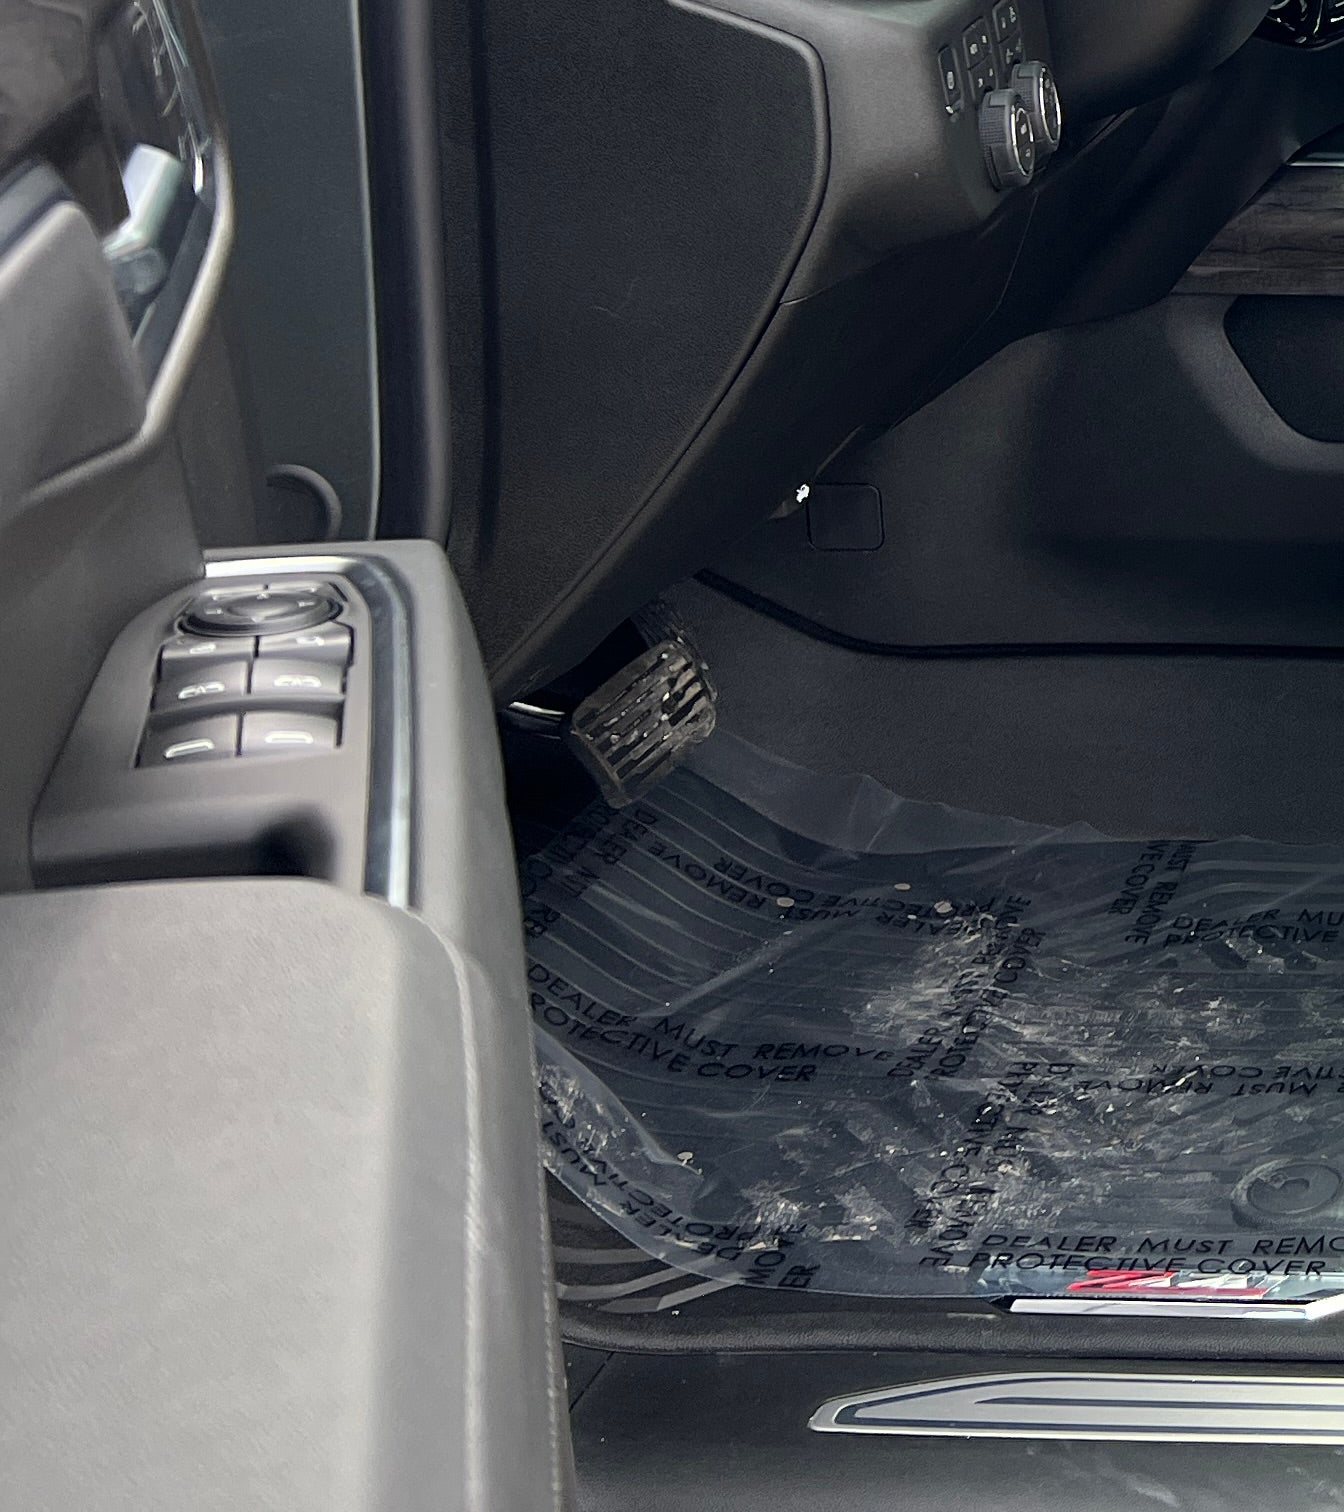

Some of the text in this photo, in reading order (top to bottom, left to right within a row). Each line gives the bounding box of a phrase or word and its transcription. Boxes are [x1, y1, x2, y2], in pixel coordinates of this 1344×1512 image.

[1172, 909, 1281, 930] DEALER
[526, 963, 895, 1063] DEALER MUST REMOVE
[697, 1062, 817, 1082] COVER
[982, 1234, 1117, 1254] DEALER
[1137, 1238, 1232, 1255] MUST
[969, 1253, 1326, 1277] PROTECTIVE COVER
